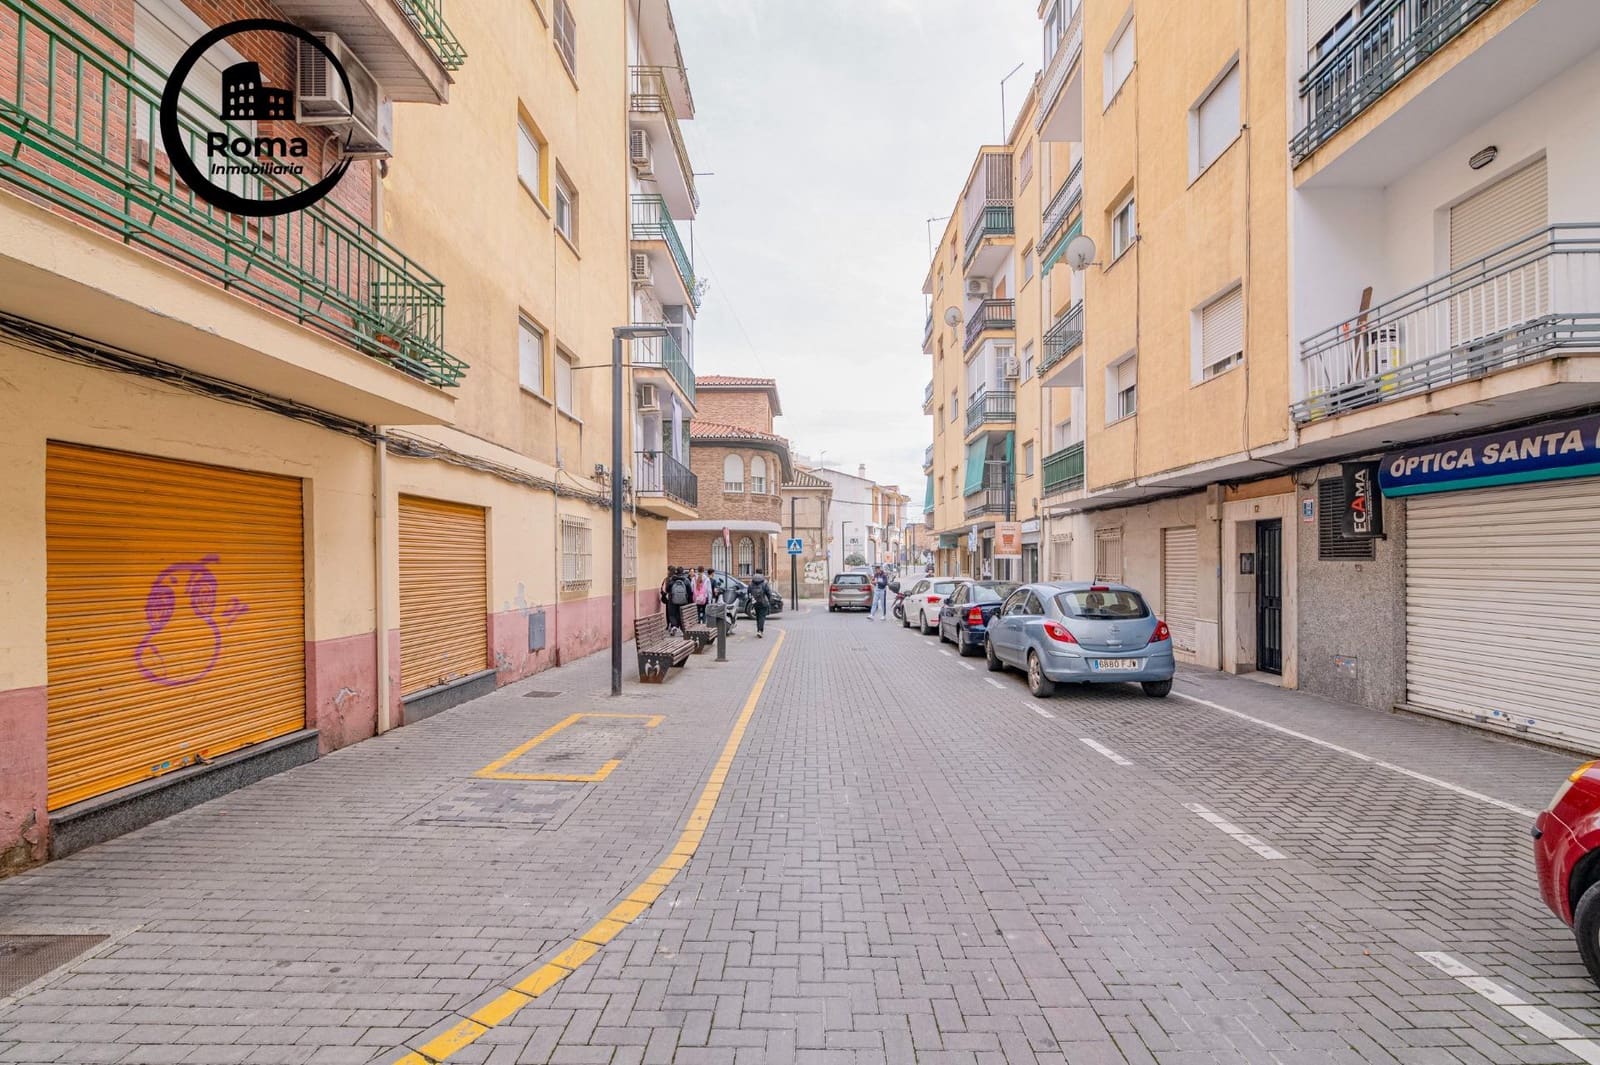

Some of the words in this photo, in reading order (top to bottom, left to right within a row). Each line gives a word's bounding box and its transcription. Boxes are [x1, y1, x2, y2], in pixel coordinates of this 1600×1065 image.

[1390, 447, 1475, 477] ÓPTICA
[1482, 430, 1584, 465] SANTA
[1351, 468, 1367, 533] ECAMA
